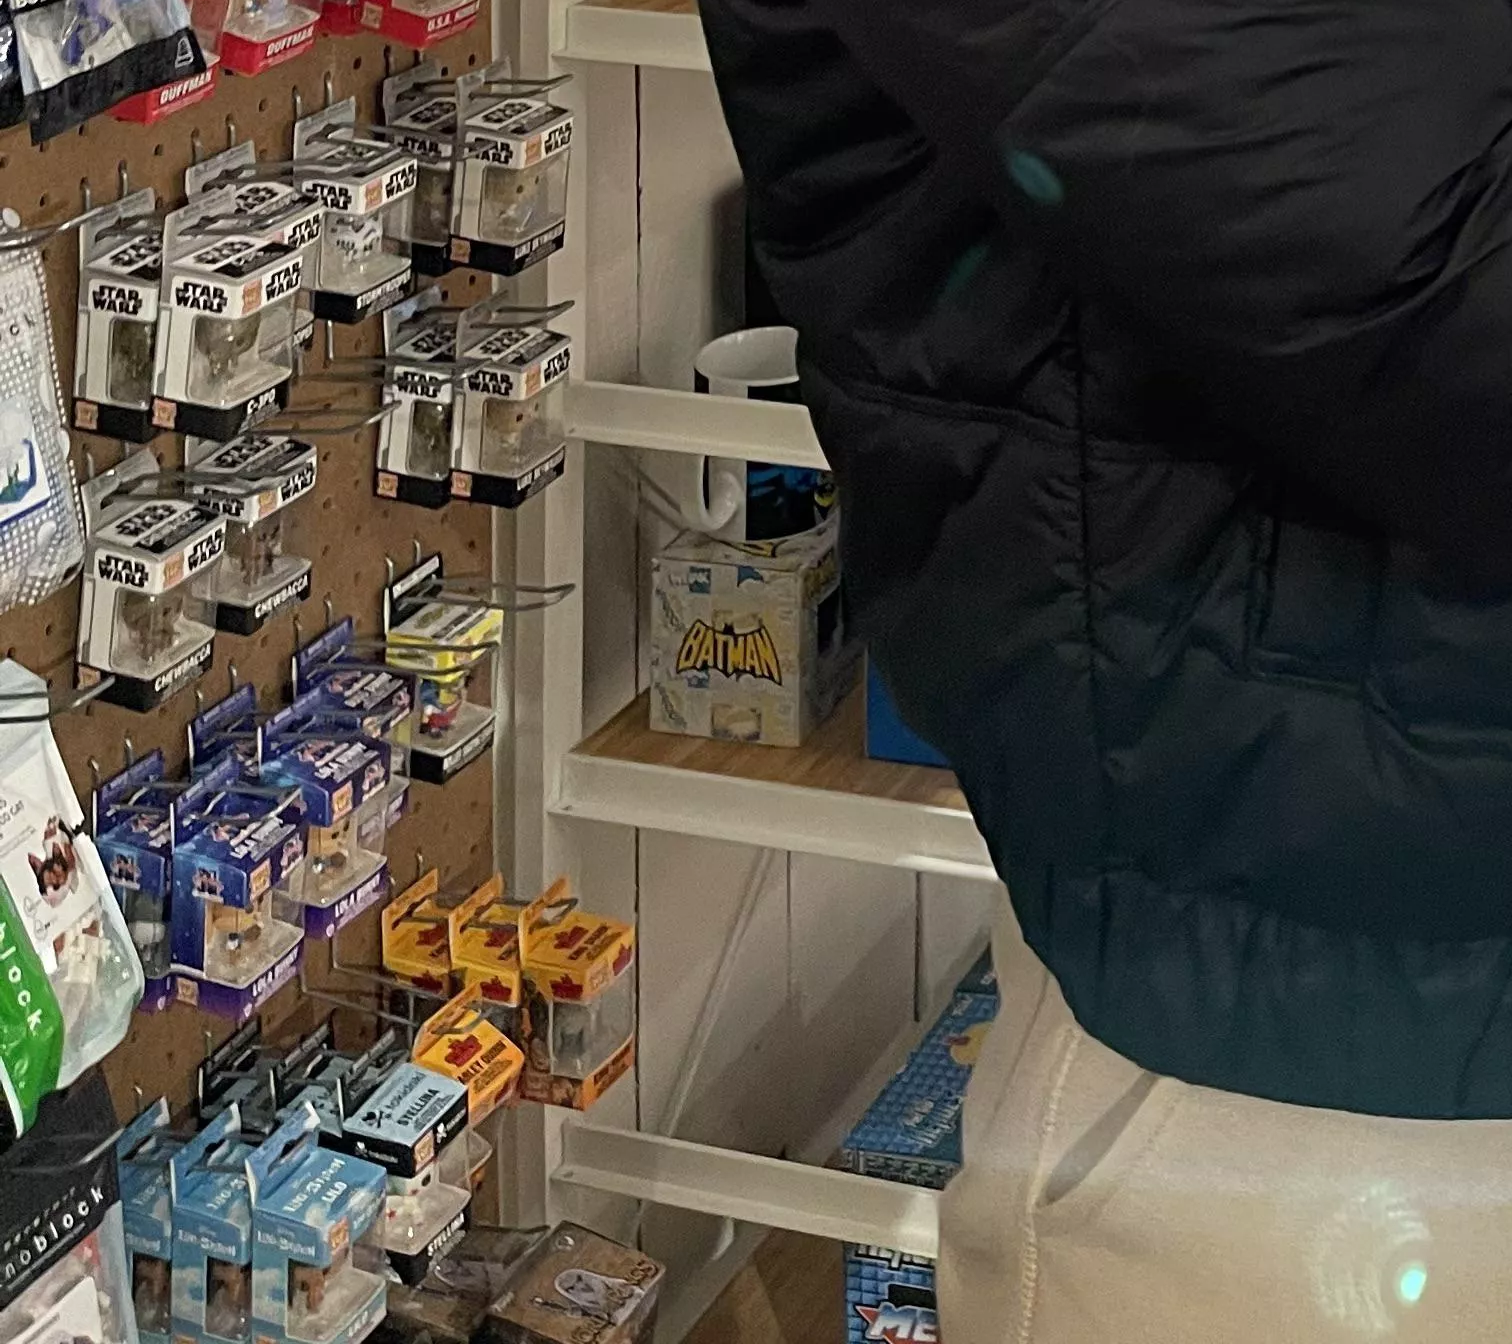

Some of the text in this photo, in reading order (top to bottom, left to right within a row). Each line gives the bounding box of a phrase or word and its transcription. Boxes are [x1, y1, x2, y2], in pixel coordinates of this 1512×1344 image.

[267, 24, 314, 58] DUFFMAN
[159, 71, 212, 106] DUFFMAN
[547, 122, 572, 144] STAR
[385, 175, 416, 199] WARS
[387, 163, 416, 186] STAR
[305, 182, 349, 199] STAR
[289, 213, 321, 238] STAR
[266, 261, 301, 289] STAR
[98, 285, 140, 302] STAR
[175, 288, 228, 313] WARS
[182, 282, 226, 299] STAR
[264, 275, 301, 302] WARS
[92, 291, 143, 315] WARS
[467, 378, 513, 397] WARS
[470, 370, 511, 385] STAR
[192, 528, 225, 557] STAR
[105, 554, 147, 573] STAR
[187, 542, 223, 572] WARS
[98, 560, 148, 588] WARS
[254, 574, 309, 619] CHEWBACCA
[676, 619, 782, 686] BATMAN
[155, 643, 212, 693] CHEWBACCA
[397, 1086, 440, 1128] STELLINA
